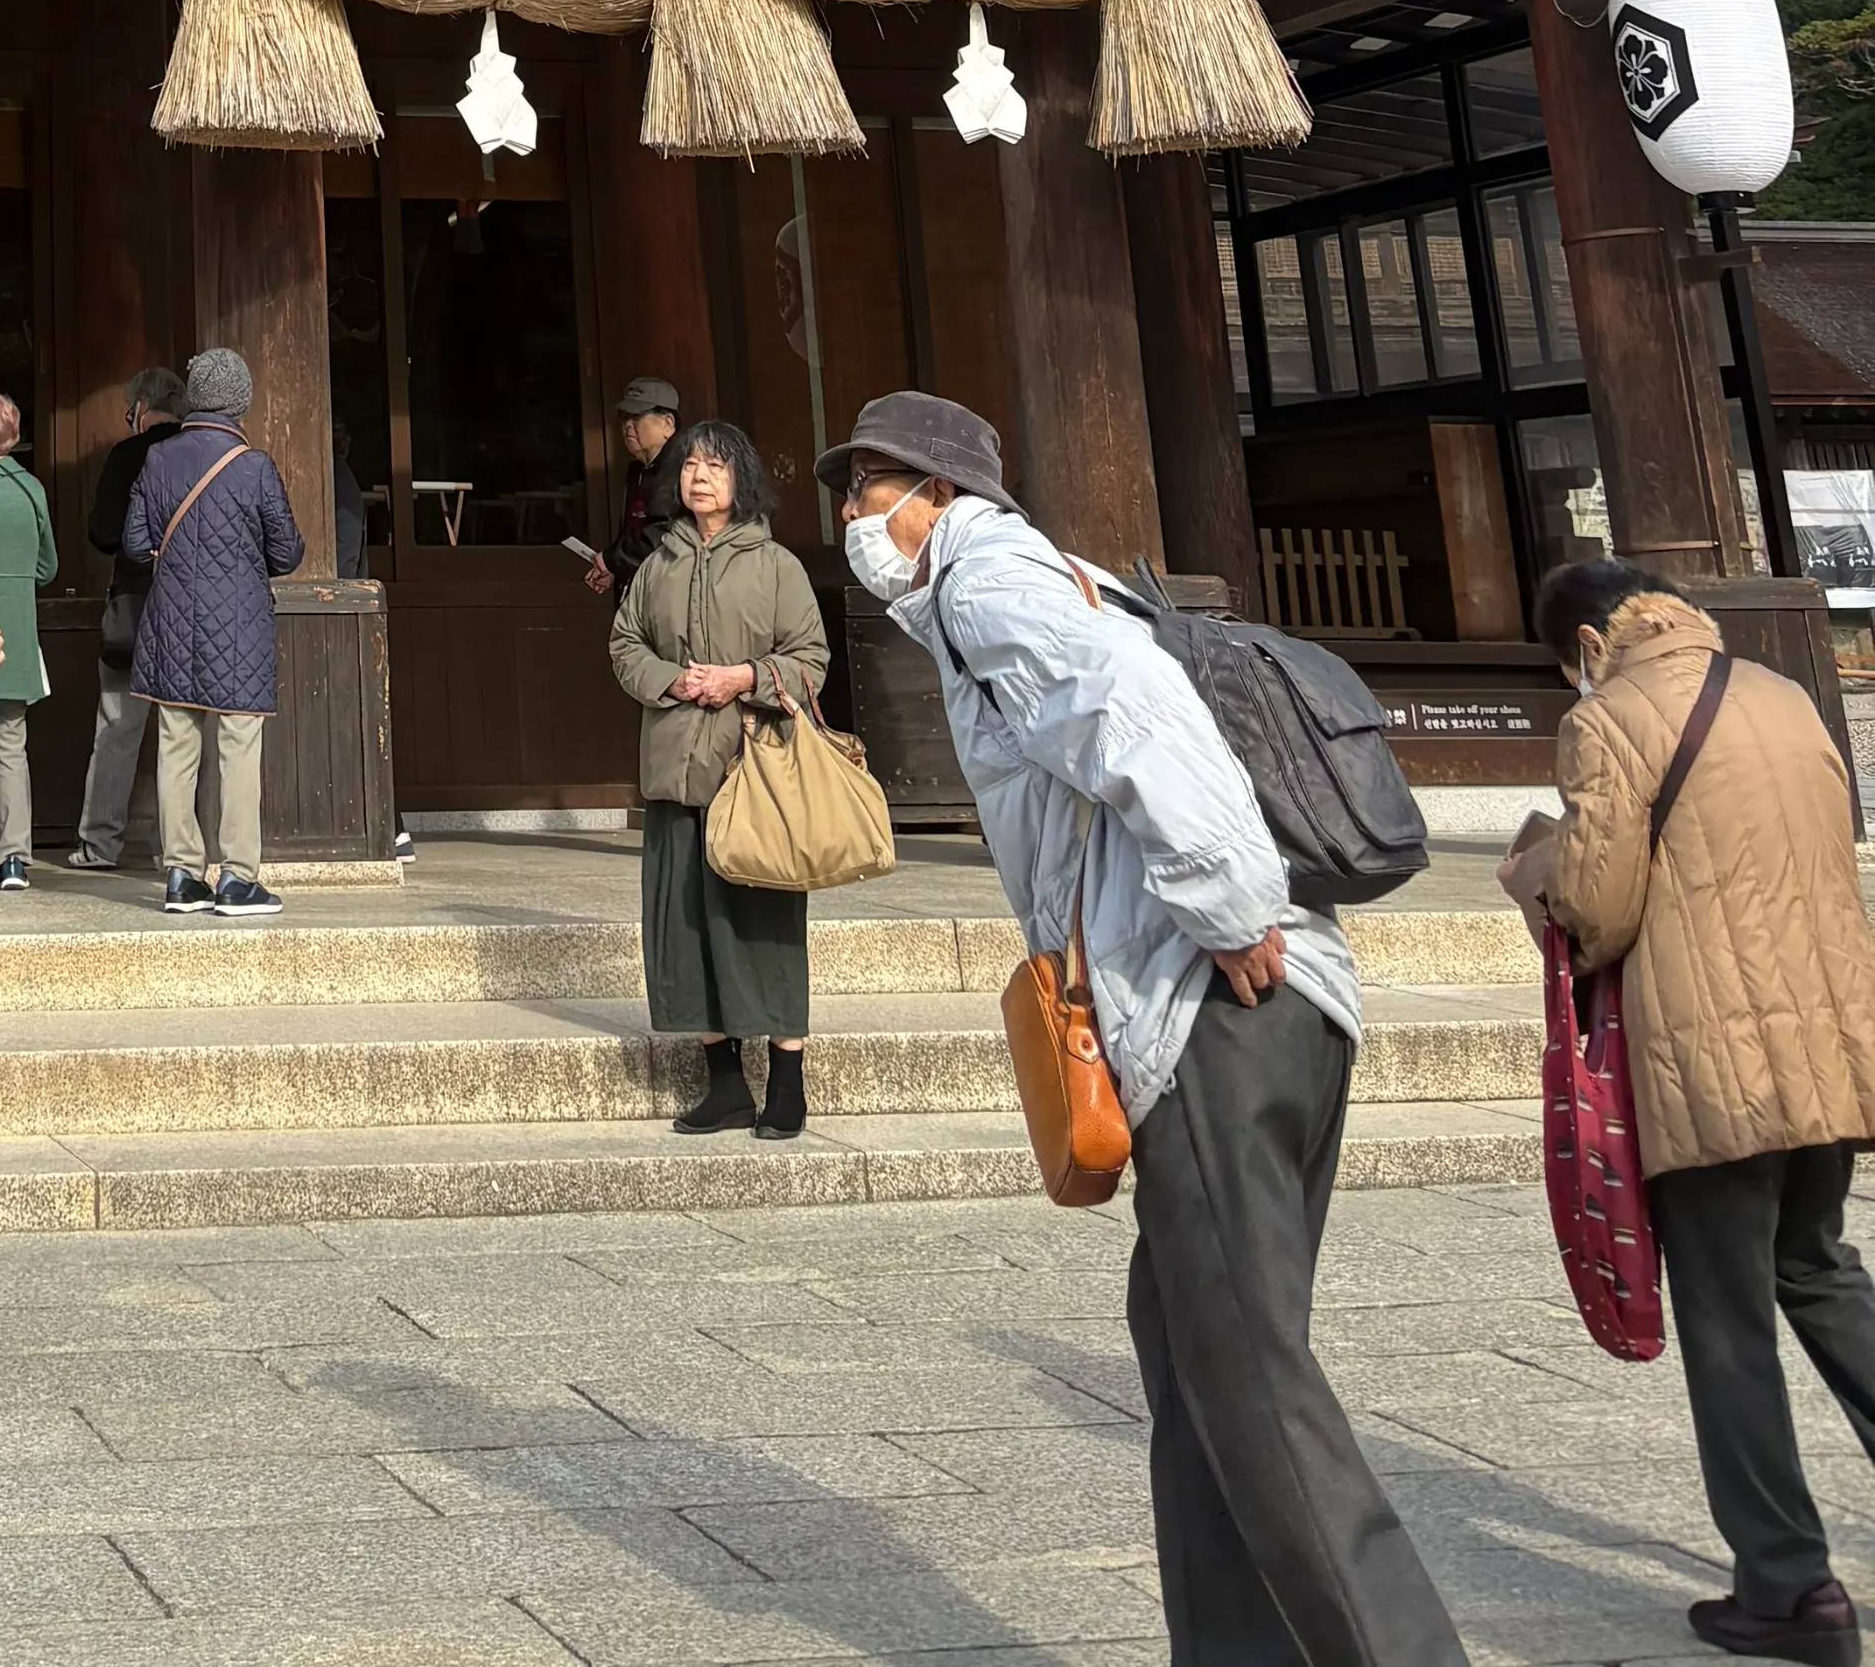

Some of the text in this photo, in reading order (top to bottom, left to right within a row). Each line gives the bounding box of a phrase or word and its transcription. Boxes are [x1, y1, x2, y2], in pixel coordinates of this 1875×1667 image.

[1421, 704, 1521, 715] Please take off your shoes
